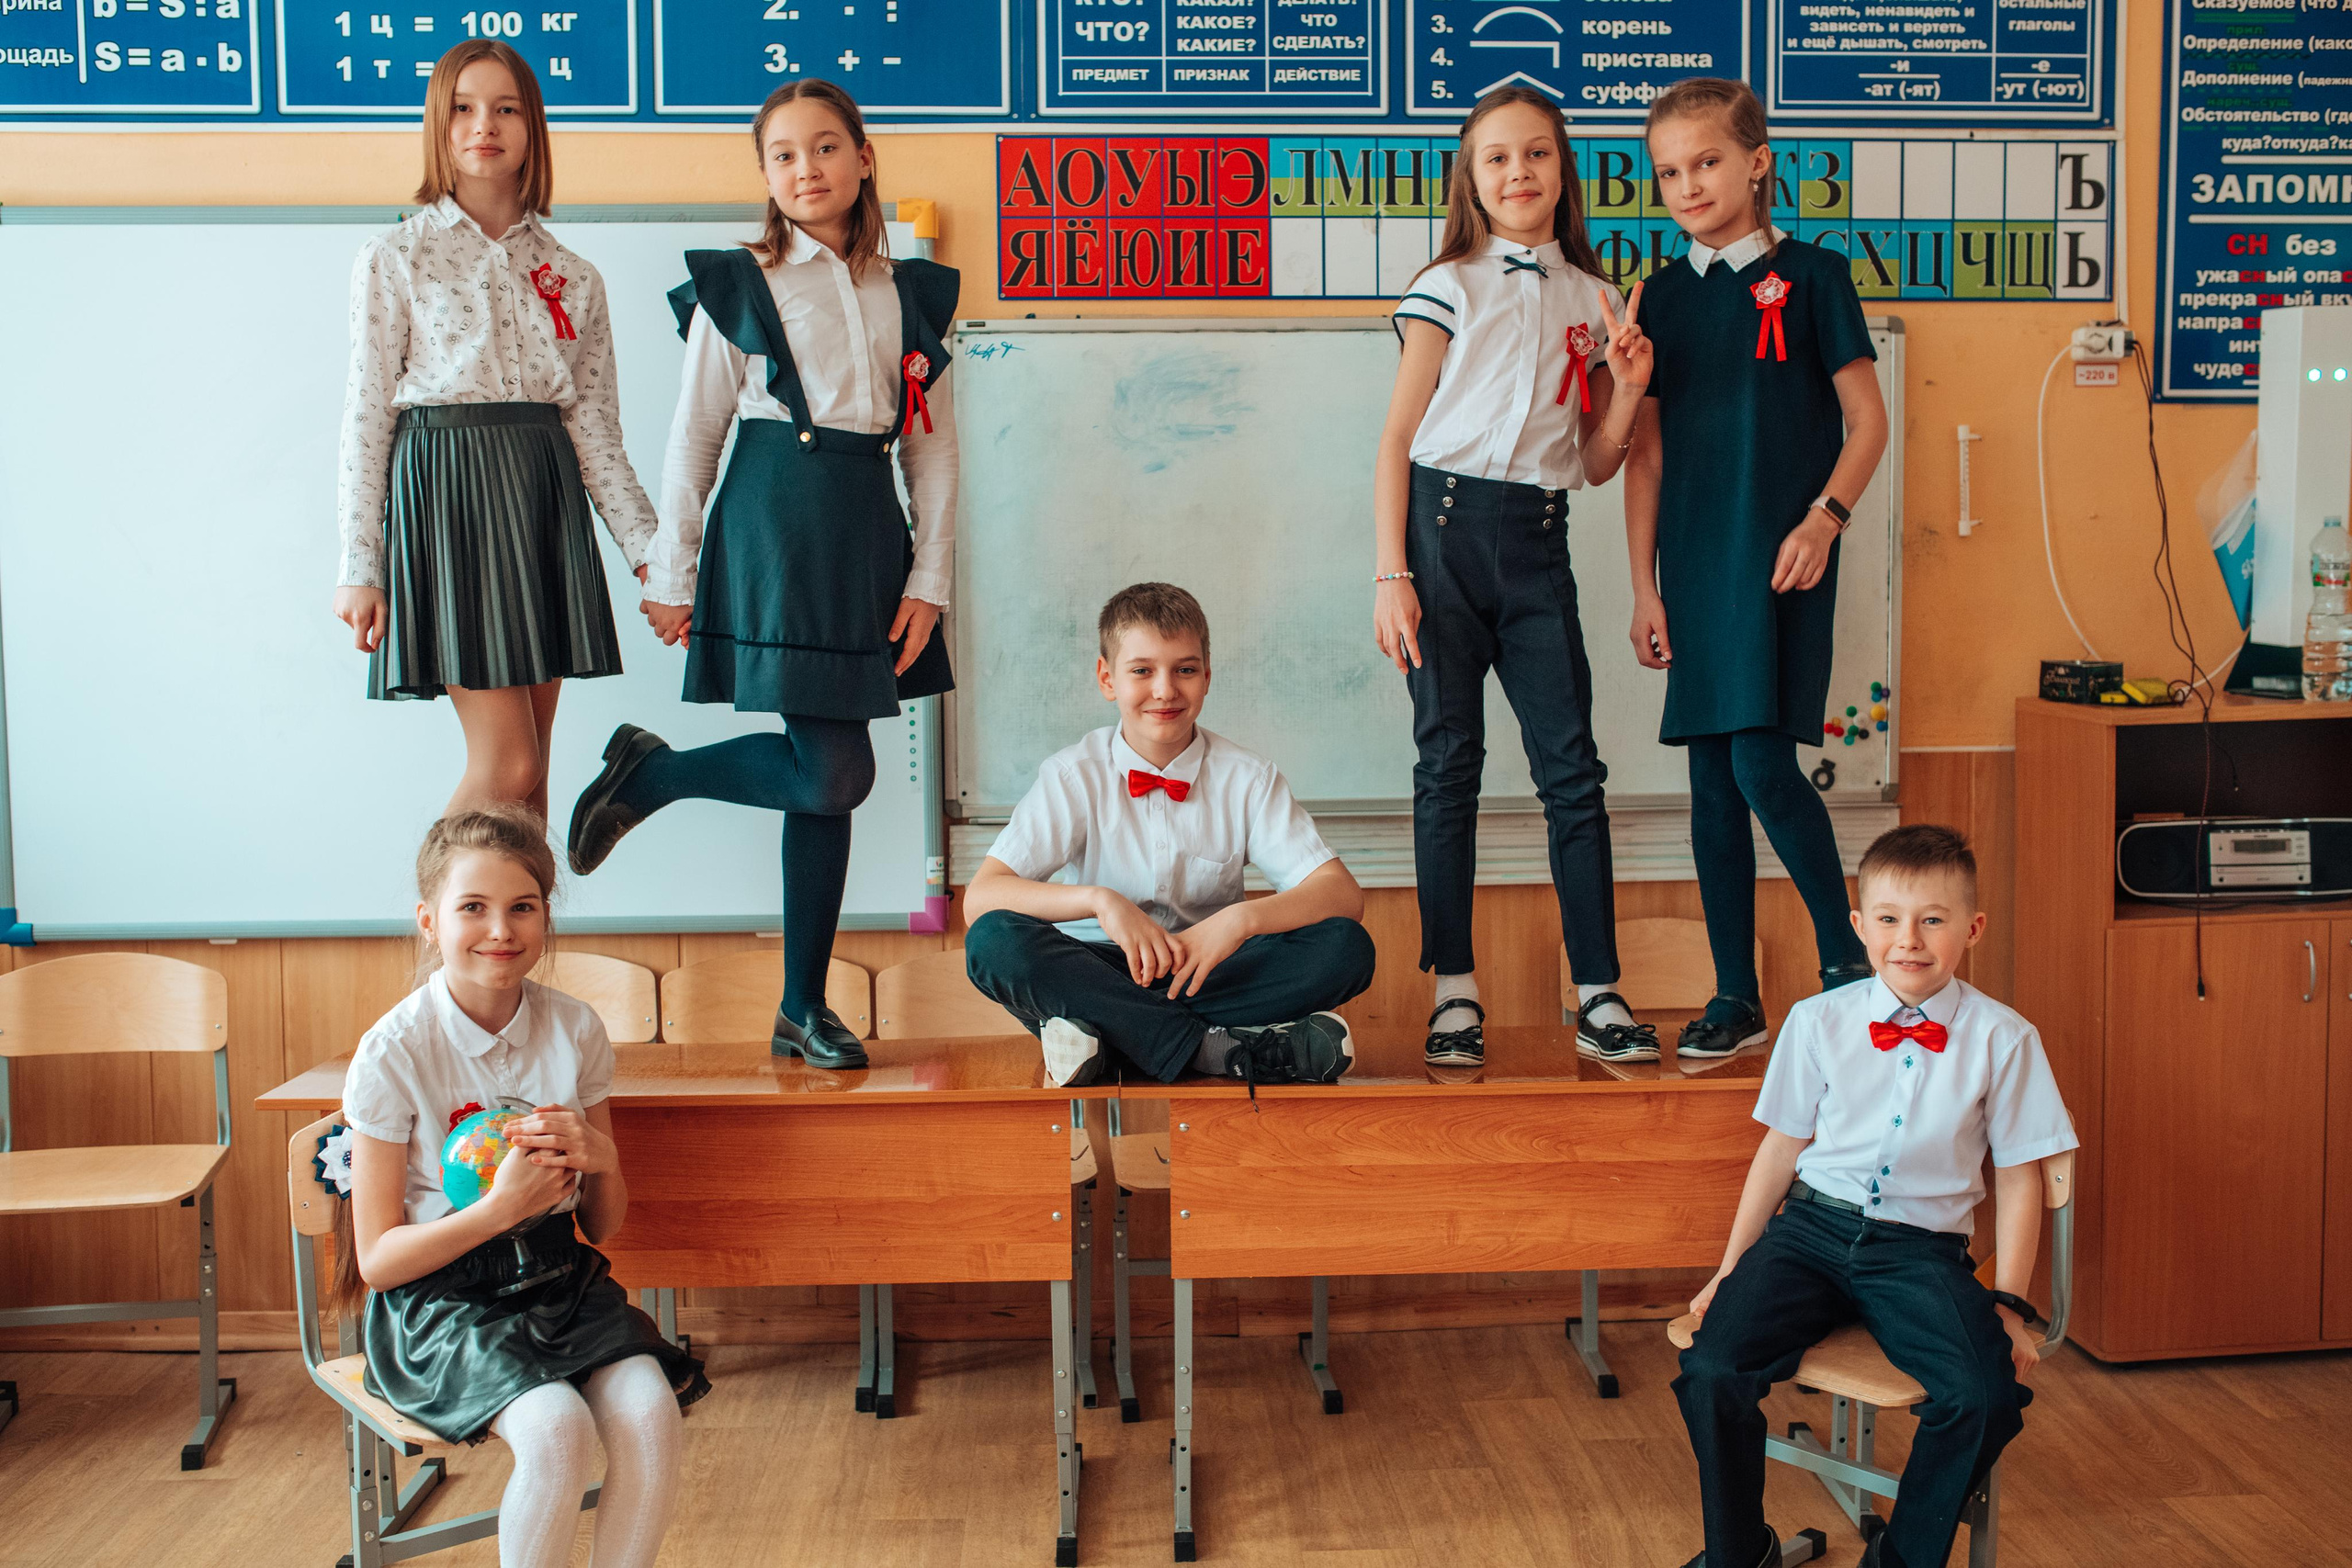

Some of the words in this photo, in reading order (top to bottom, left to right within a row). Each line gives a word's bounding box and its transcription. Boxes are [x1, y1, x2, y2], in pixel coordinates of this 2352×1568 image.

[0, 0, 62, 15] рина
[1800, 5, 1861, 18] видеть,
[1865, 5, 1961, 18] ненавидеть
[1964, 6, 1975, 17] и
[334, 10, 351, 37] 1
[370, 15, 394, 39] ц
[460, 11, 524, 38] 100
[541, 12, 578, 32] кг
[1176, 16, 1257, 29] КАКОЕ?
[1301, 14, 1338, 27] ЧТО
[1430, 15, 1454, 34] 3.
[1582, 20, 1672, 39] корень
[1809, 21, 1884, 33] зависеть
[1888, 22, 1900, 33] и
[1904, 22, 1966, 36] вертеть
[2008, 19, 2076, 32] глаголы
[1075, 22, 1149, 42] ЧТО?
[1176, 39, 1257, 52] КАКИЕ?
[1272, 36, 1366, 51] СДЕЛАТЬ?
[1787, 38, 1798, 49] и
[1802, 37, 1837, 50] ещё
[1839, 39, 1909, 51] дышать,
[1912, 39, 1987, 52] смотреть
[2183, 35, 2304, 52] Определение
[95, 41, 122, 72] S
[161, 49, 186, 72] a
[218, 42, 243, 73] b
[763, 43, 800, 73] 3.
[1430, 47, 1454, 67] 4.
[1582, 52, 1713, 72] приставка
[336, 55, 353, 82] 1
[373, 59, 391, 79] т
[549, 57, 572, 81] ц
[1072, 69, 1149, 83] ПРЕДМЕТ
[1173, 69, 1250, 82] ПРИЗНАК
[1273, 67, 1362, 84] ДЕЙСТВИЕ
[2181, 70, 2294, 88] Дополнение
[2298, 71, 2352, 88] (падежн
[1430, 80, 1454, 99] 5.
[2032, 79, 2085, 100] (-ют)
[2181, 107, 2321, 122] Обстоятельство
[1001, 149, 1053, 208] А
[1057, 148, 1107, 208] О
[1108, 149, 1161, 208] У
[1163, 149, 1216, 207] Ы
[1220, 148, 1266, 208] Э
[1272, 148, 1322, 207] Л
[1324, 148, 1378, 207] М
[1377, 148, 1430, 207] Н
[1594, 151, 1636, 208] В
[1806, 151, 1844, 209] З
[2060, 153, 2105, 210] Ъ
[2226, 233, 2268, 255] СН
[2285, 233, 2336, 256] без
[1002, 229, 1053, 288] Я
[1059, 219, 1103, 288] Ё
[1110, 229, 1162, 288] Ю
[1163, 229, 1215, 288] И
[1219, 229, 1265, 288] Е
[1594, 230, 1641, 287] Ф
[1851, 230, 1897, 288] Х
[1903, 231, 1949, 297] Ц
[1958, 231, 2003, 288] Ч
[2004, 231, 2054, 298] Щ
[2062, 231, 2101, 288] Ь
[2196, 266, 2297, 288] ужасный
[2179, 289, 2314, 310] прекрасный
